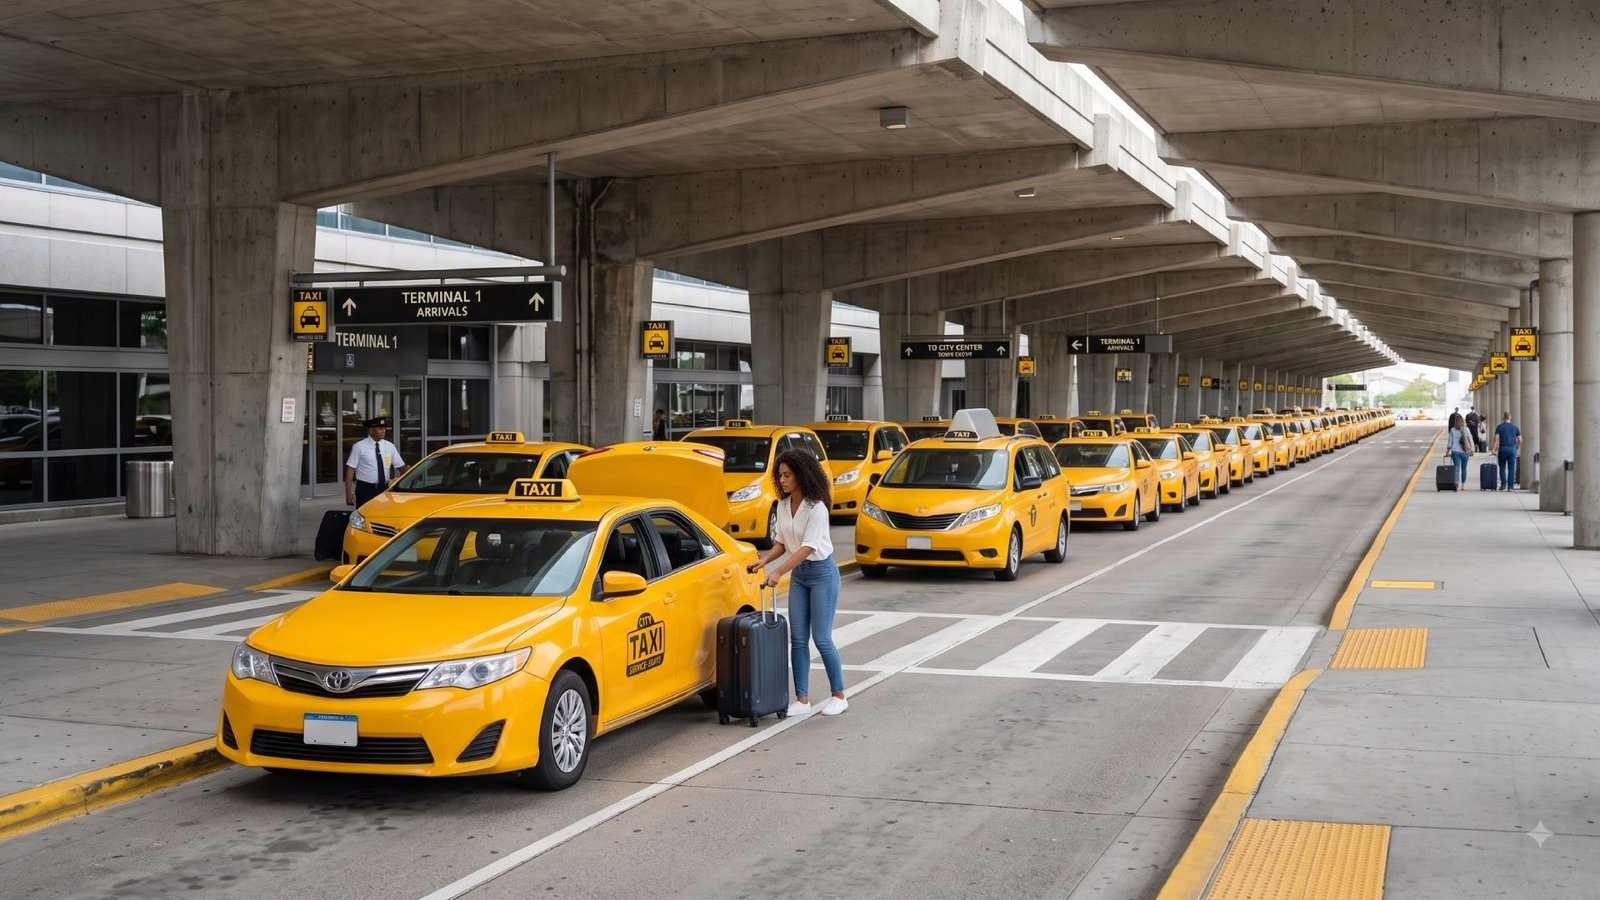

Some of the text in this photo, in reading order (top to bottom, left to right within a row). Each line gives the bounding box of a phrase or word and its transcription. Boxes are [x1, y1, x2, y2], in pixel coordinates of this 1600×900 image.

[299, 292, 321, 300] TAXI
[402, 290, 481, 304] TERMINAL 1
[416, 306, 468, 317] ARRIVALS
[336, 332, 397, 349] TERMINAL 1
[520, 483, 556, 496] TAXI
[638, 615, 653, 628] CITY
[630, 626, 663, 660] TAXI
